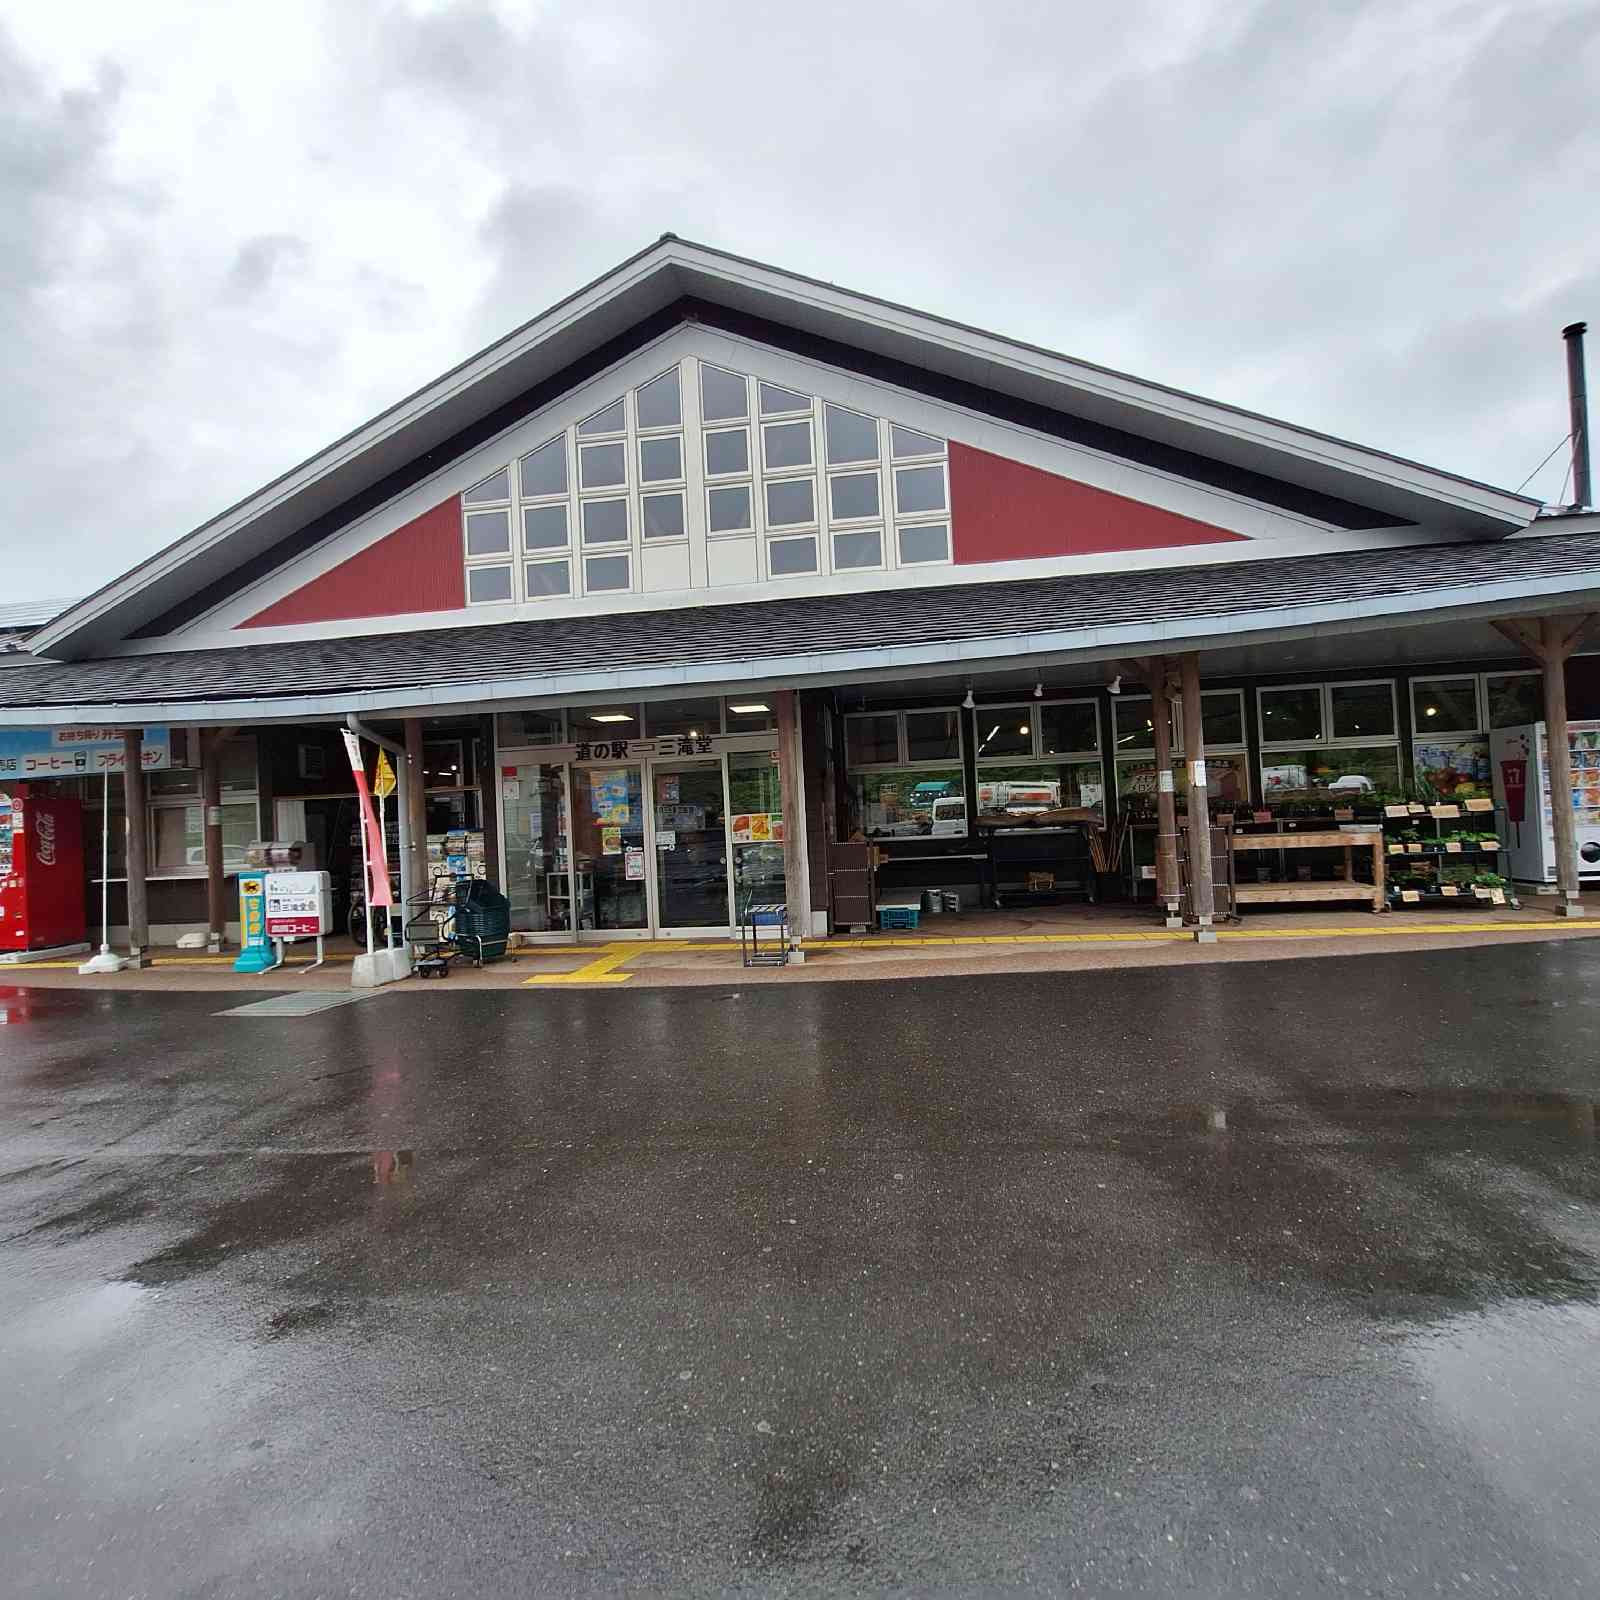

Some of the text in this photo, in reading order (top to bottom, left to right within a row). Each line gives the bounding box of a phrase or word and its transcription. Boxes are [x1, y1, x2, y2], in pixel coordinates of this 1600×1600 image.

[575, 735, 713, 761] 道の駅 三滝堂
[25, 757, 73, 771] コーヒー
[97, 751, 163, 768] フライキン
